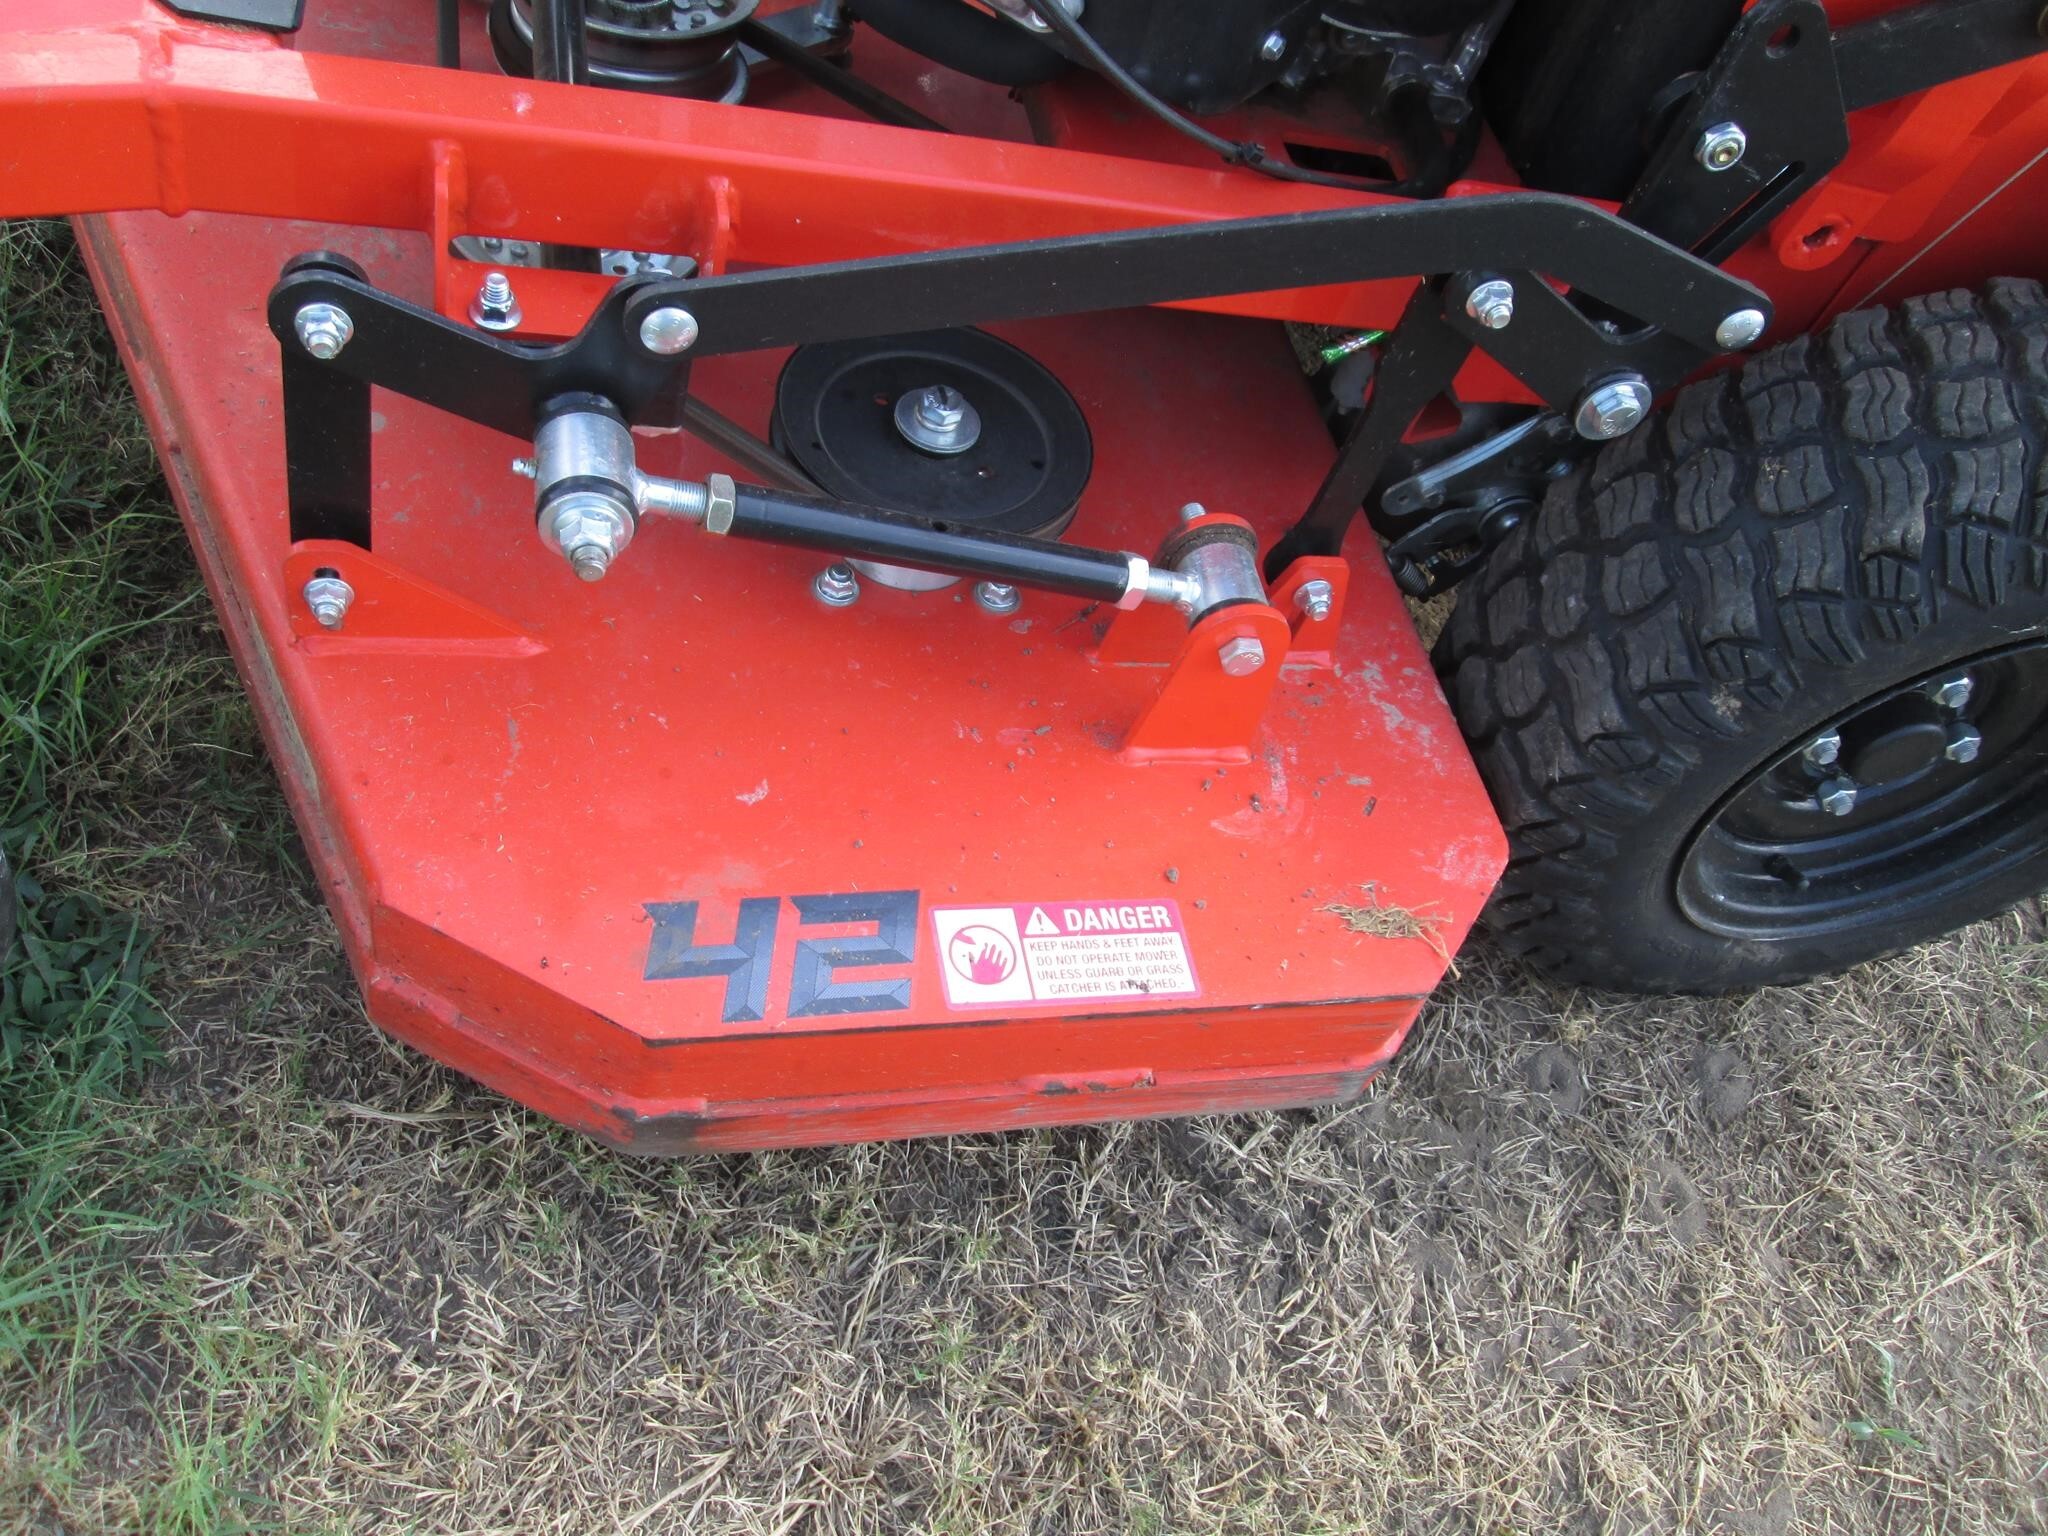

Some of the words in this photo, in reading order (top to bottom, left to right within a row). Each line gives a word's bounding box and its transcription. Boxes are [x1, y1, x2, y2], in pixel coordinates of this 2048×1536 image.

[1063, 905, 1172, 931] DANGER
[1030, 940, 1058, 951] KEEP
[1061, 939, 1101, 950] HANDS
[1103, 938, 1112, 948] &
[1114, 937, 1140, 948] FEET
[641, 889, 920, 1023] 42
[1037, 955, 1053, 966] DO
[1056, 954, 1079, 965] NOT
[1081, 952, 1132, 964] OPERATE
[1135, 950, 1178, 962] MOWER
[1037, 968, 1082, 980] UNLESS
[1085, 967, 1124, 978] GUARD
[1127, 966, 1143, 976] OR
[1147, 964, 1184, 975] GRASS
[1049, 983, 1102, 994] CATCHER
[1105, 982, 1117, 992] IS
